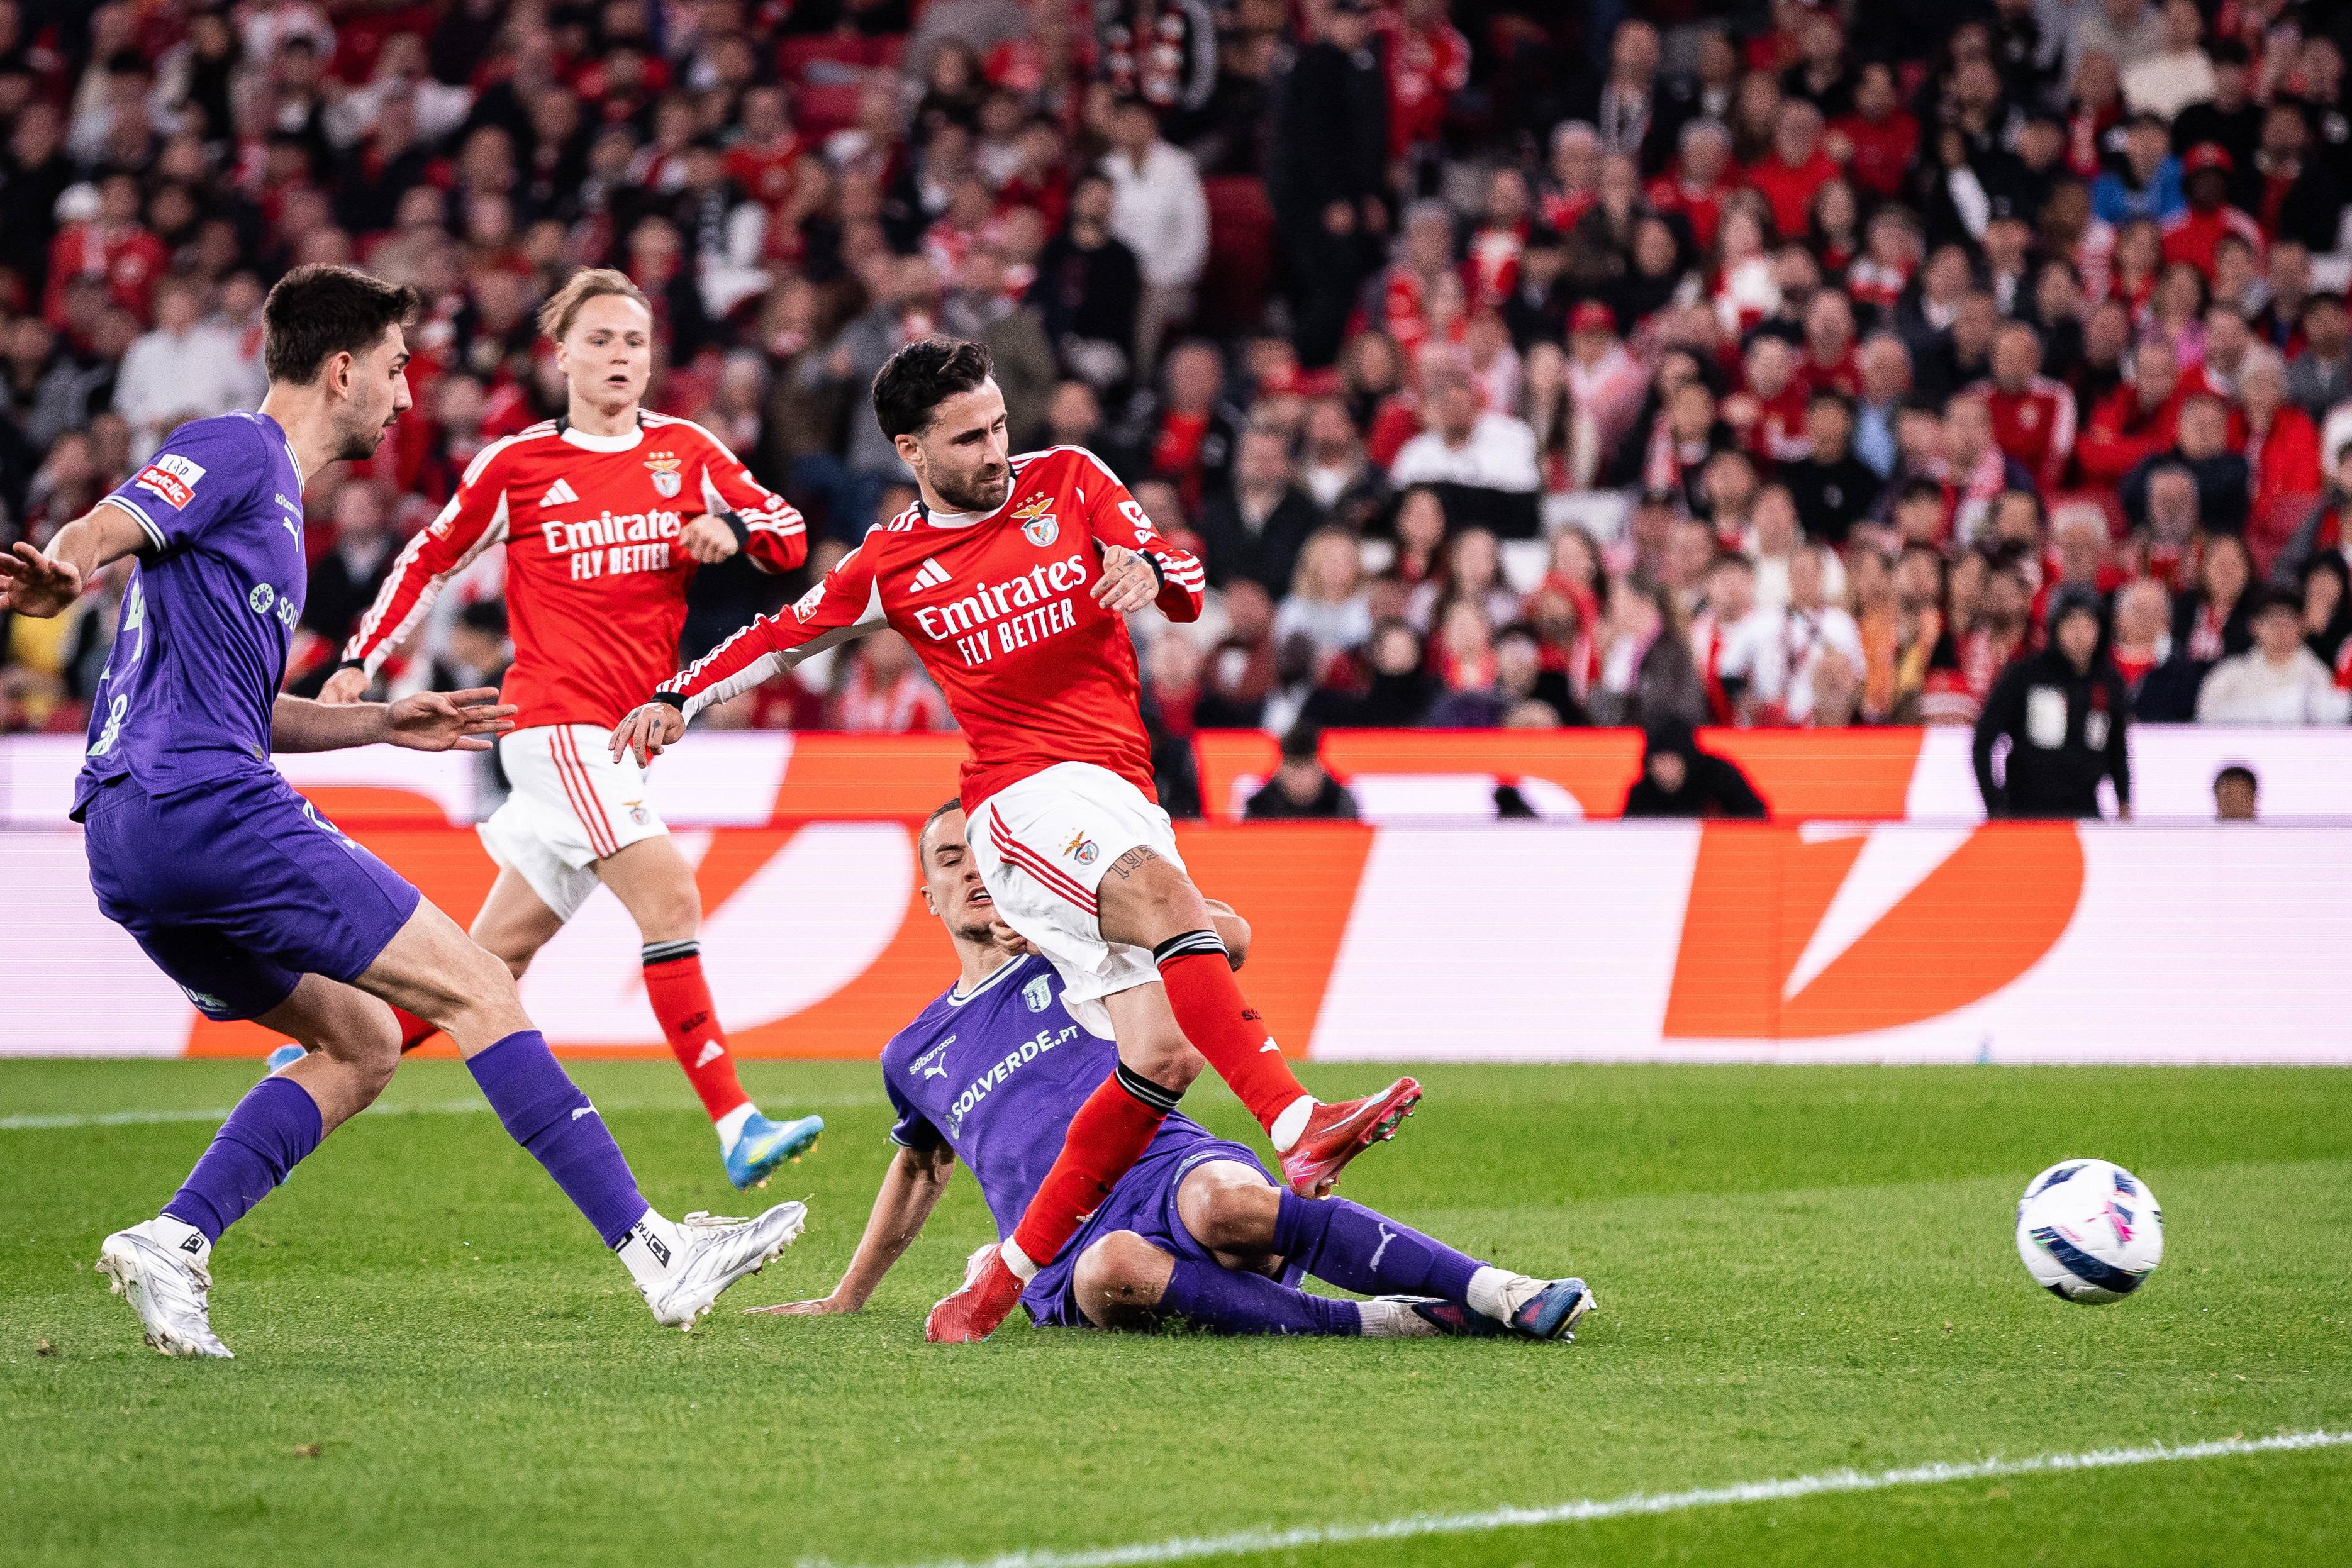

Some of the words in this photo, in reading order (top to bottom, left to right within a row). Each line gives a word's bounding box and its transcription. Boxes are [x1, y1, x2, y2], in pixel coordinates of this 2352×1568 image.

[142, 469, 187, 503] Betclic
[541, 508, 682, 554] Emirates
[571, 549, 603, 581] FLY
[608, 542, 670, 575] BETTER
[913, 555, 1087, 640] Emirates
[956, 629, 992, 667] FLY
[996, 598, 1077, 654] BETTER
[952, 1025, 1079, 1123] SOLVERDE.PT
